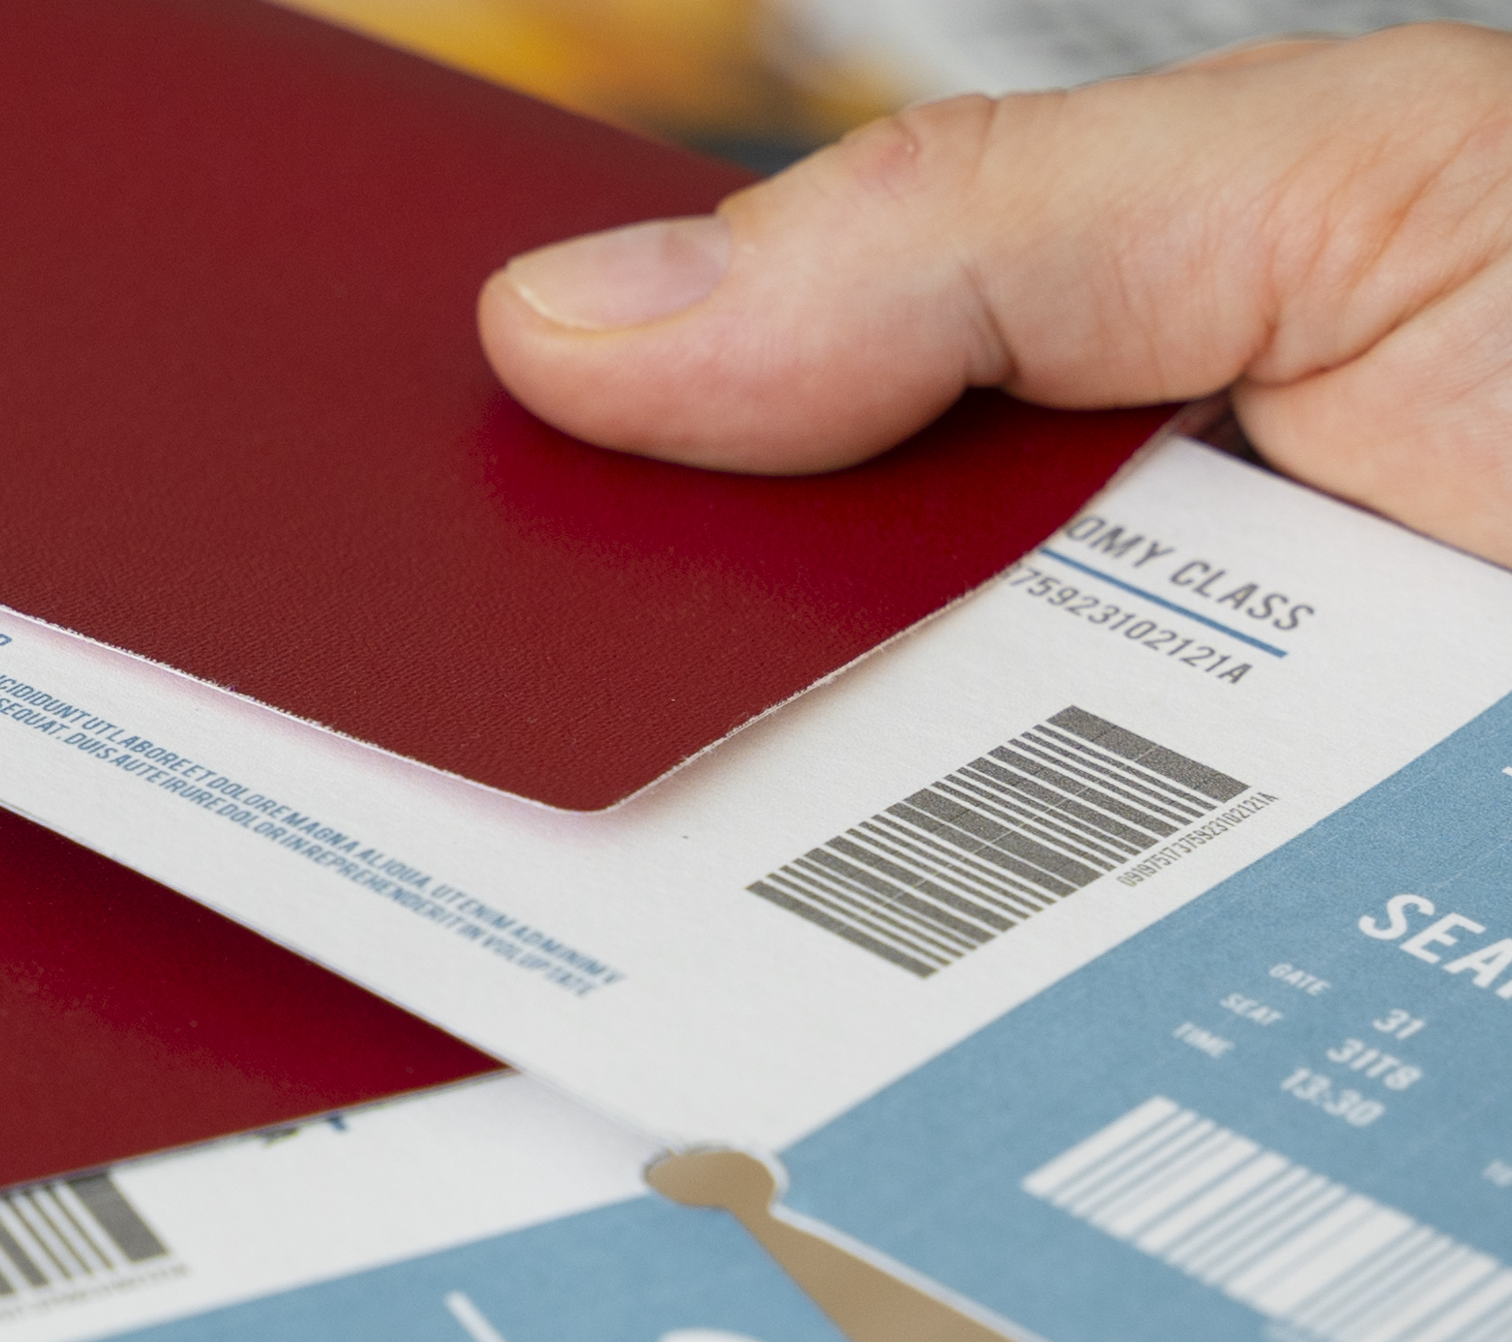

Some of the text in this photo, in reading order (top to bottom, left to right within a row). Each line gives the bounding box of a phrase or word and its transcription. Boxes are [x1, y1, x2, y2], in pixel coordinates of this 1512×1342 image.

[1000, 562, 1254, 685] 75923102121A
[1168, 558, 1316, 633] CLASS
[1372, 1008, 1426, 1041] 31
